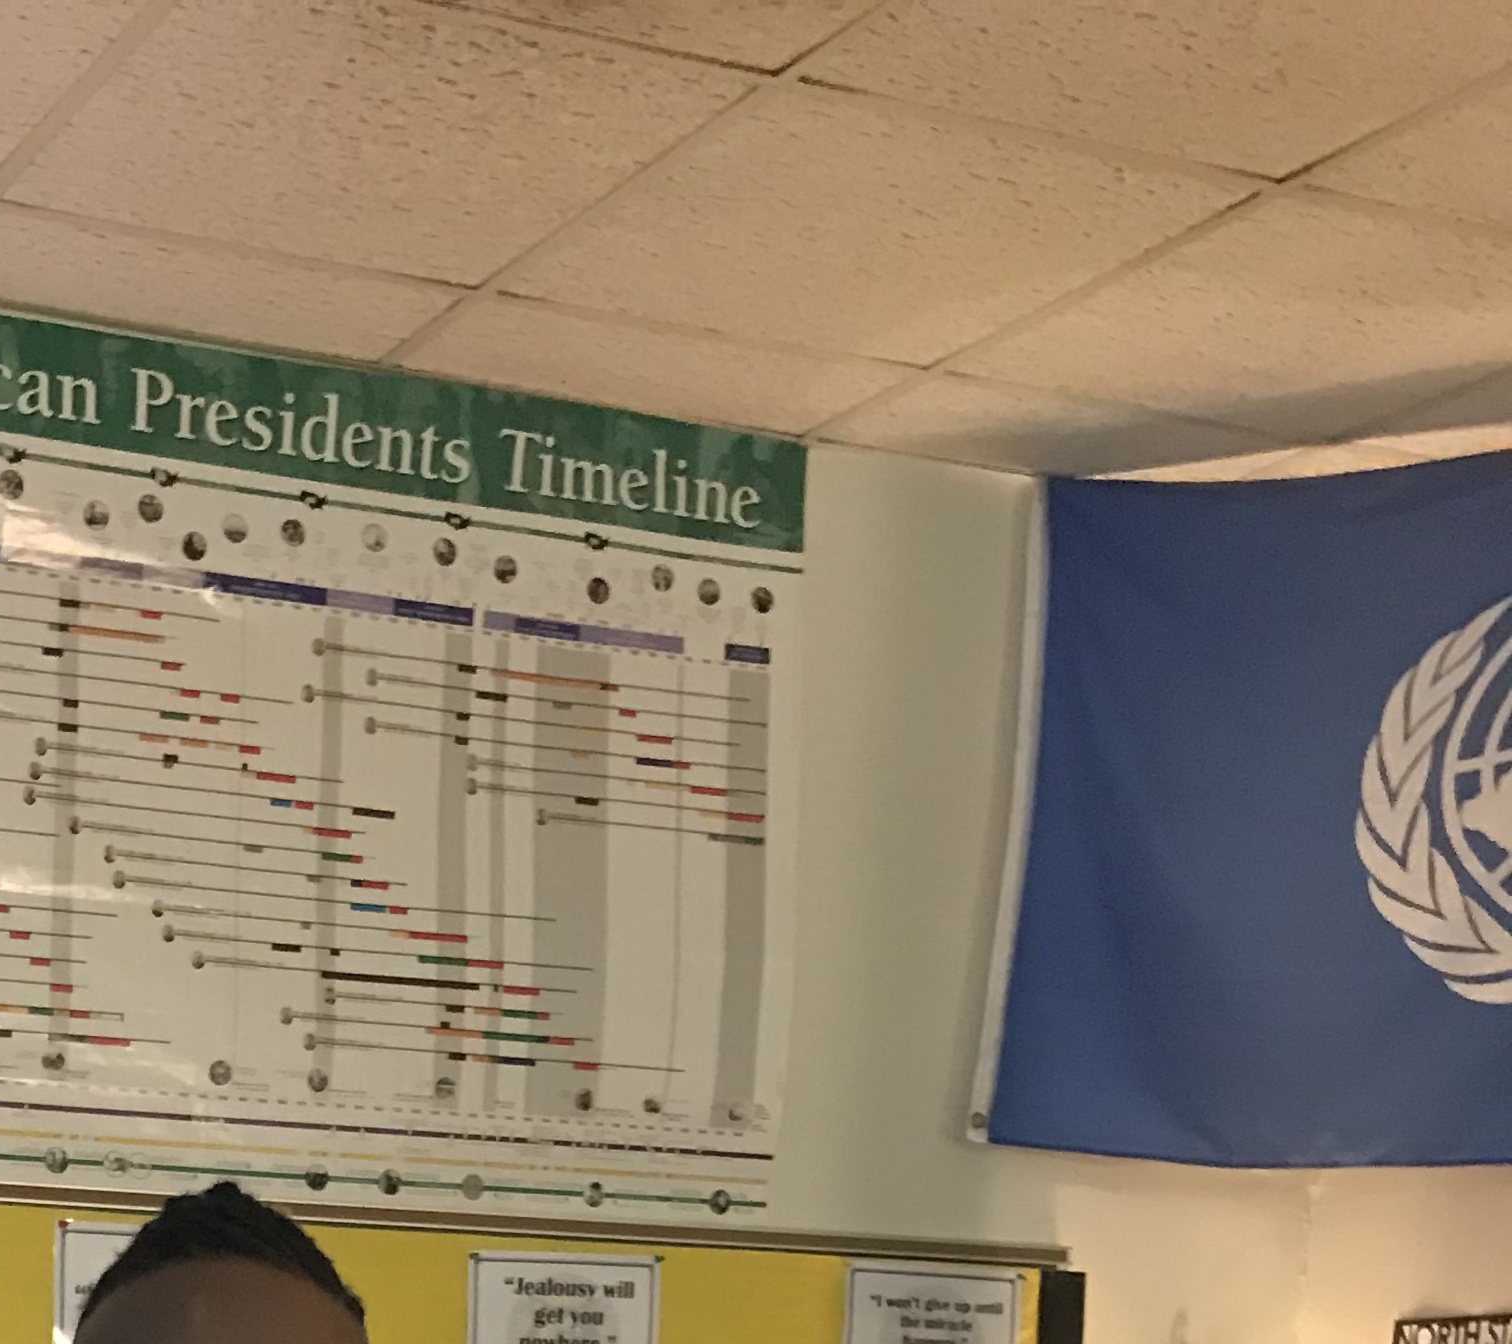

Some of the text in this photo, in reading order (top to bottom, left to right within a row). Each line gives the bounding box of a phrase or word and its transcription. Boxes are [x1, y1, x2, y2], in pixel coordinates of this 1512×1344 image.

[130, 367, 472, 484] Presidents
[500, 428, 762, 529] Timeline
[603, 1280, 636, 1299] will
[533, 1307, 605, 1330] get you
